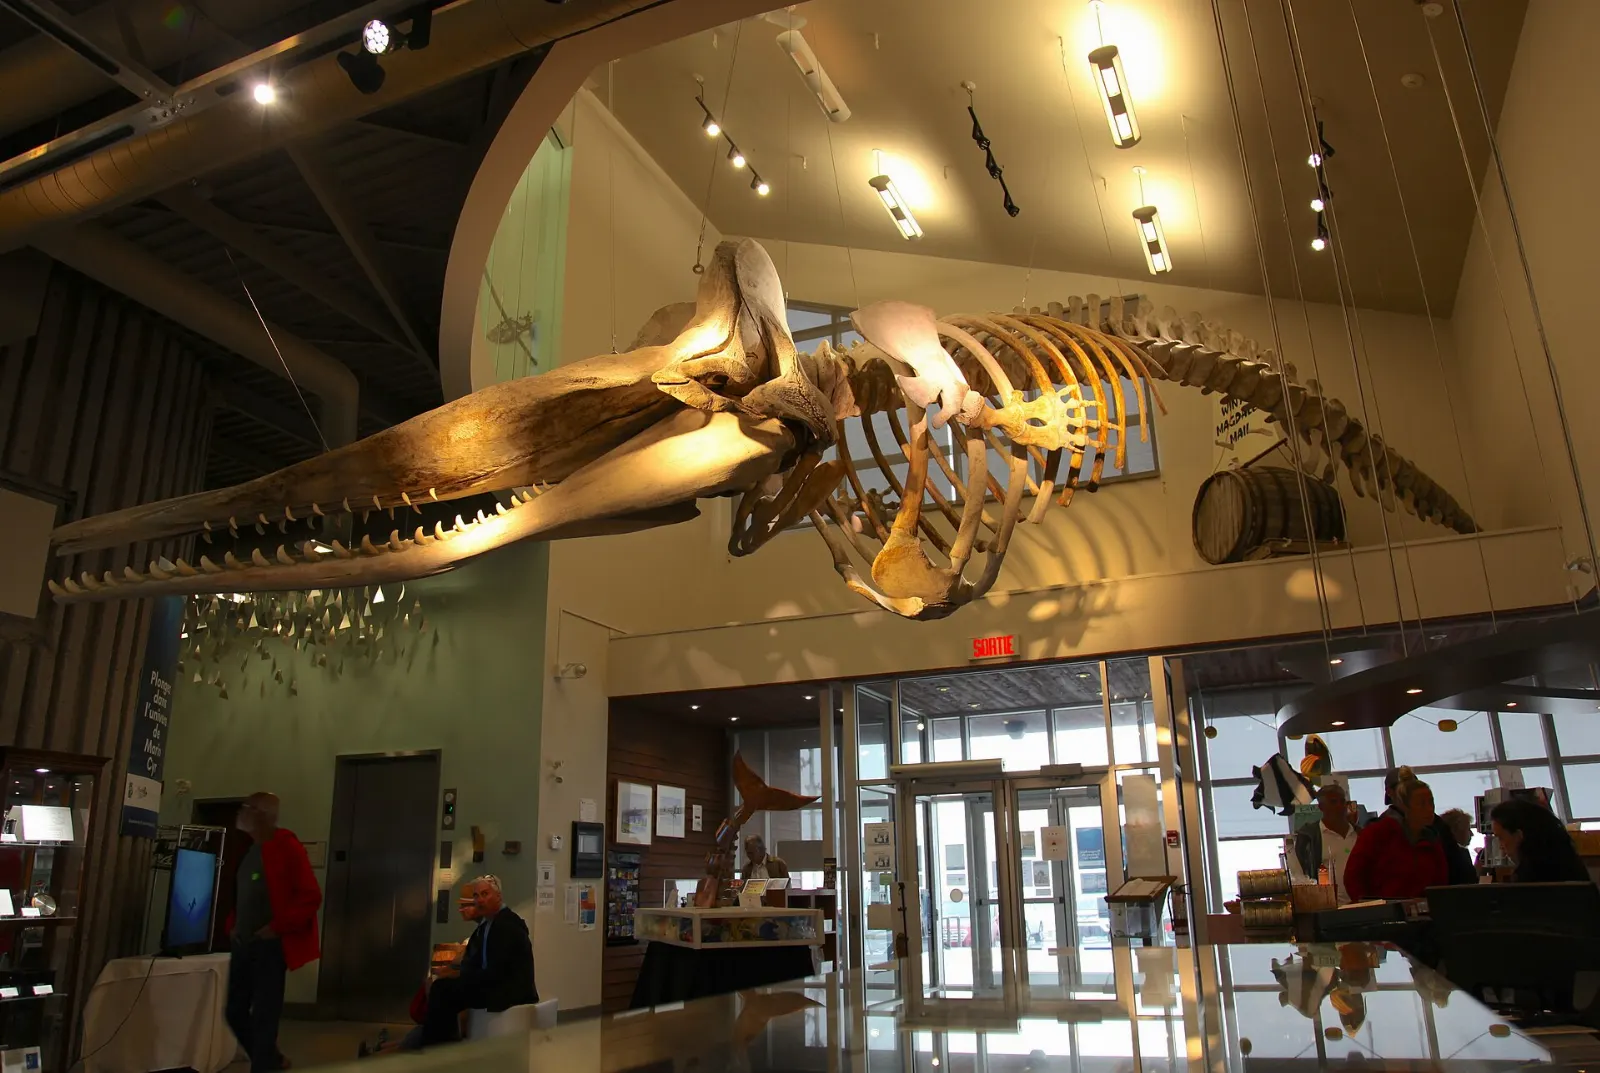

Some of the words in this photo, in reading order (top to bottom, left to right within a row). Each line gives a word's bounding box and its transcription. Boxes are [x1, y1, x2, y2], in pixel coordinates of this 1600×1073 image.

[973, 635, 1015, 658] SORTIE
[152, 724, 160, 739] de
[146, 757, 157, 777] Cyr
